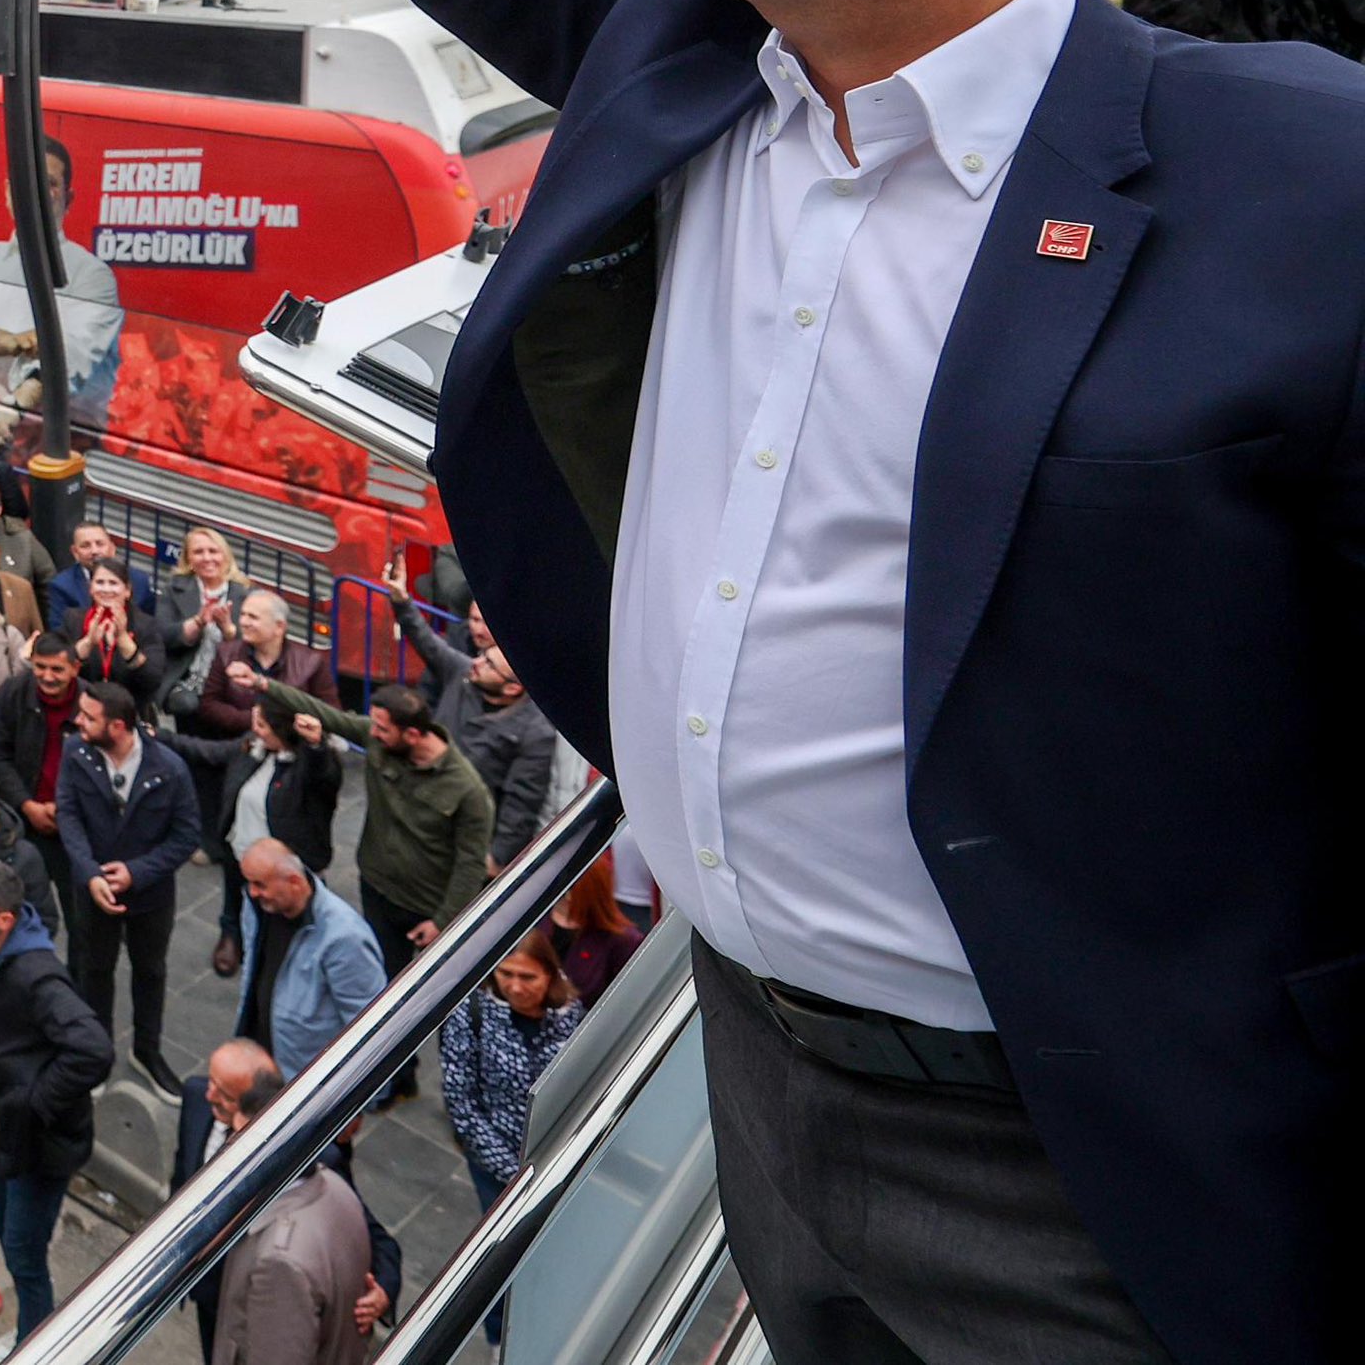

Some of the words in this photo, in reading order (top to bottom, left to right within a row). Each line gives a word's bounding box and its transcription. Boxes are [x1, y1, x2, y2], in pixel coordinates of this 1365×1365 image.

[101, 162, 202, 192] EKREM
[99, 193, 299, 228] İMAMOĞLU'NA
[96, 228, 248, 265] ÖZGÜRLÜK
[1047, 244, 1078, 254] CHP
